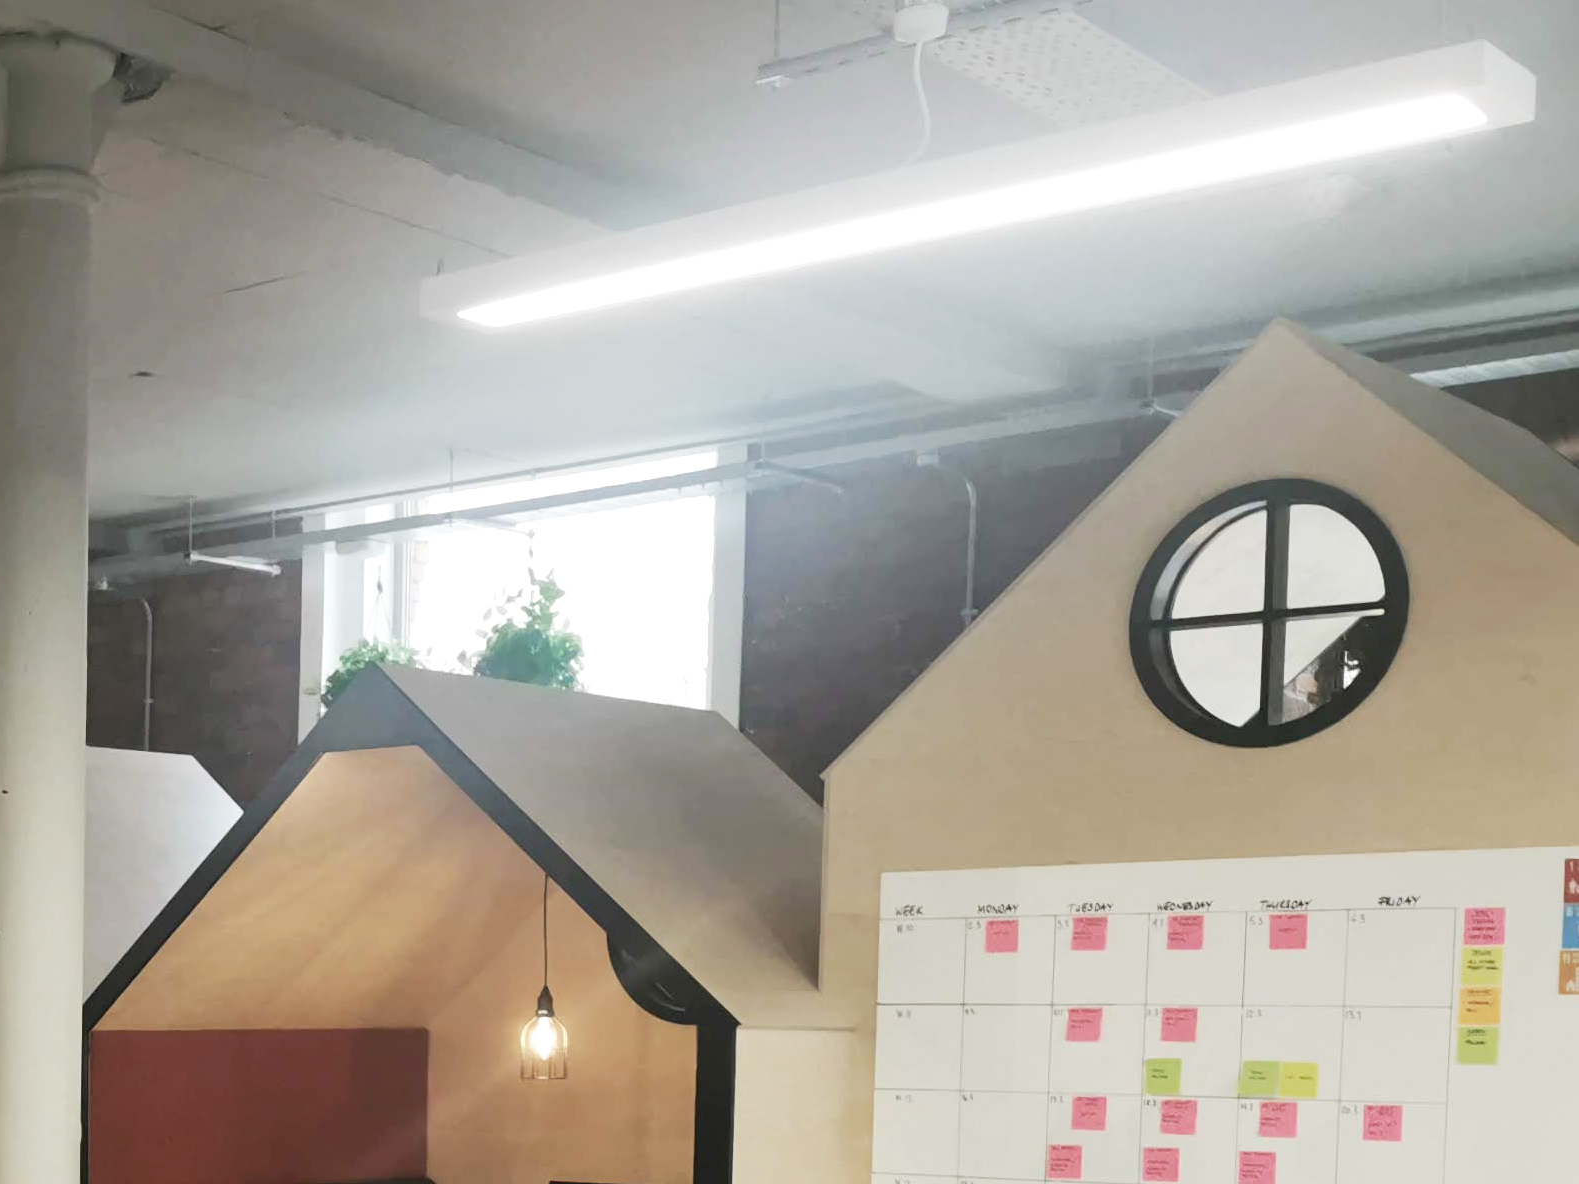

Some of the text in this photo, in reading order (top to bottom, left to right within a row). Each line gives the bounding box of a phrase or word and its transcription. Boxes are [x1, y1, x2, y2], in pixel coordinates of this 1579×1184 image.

[895, 904, 923, 917] WEEK
[977, 903, 1020, 915] MONDAY
[1068, 902, 1114, 914] TUESDAY
